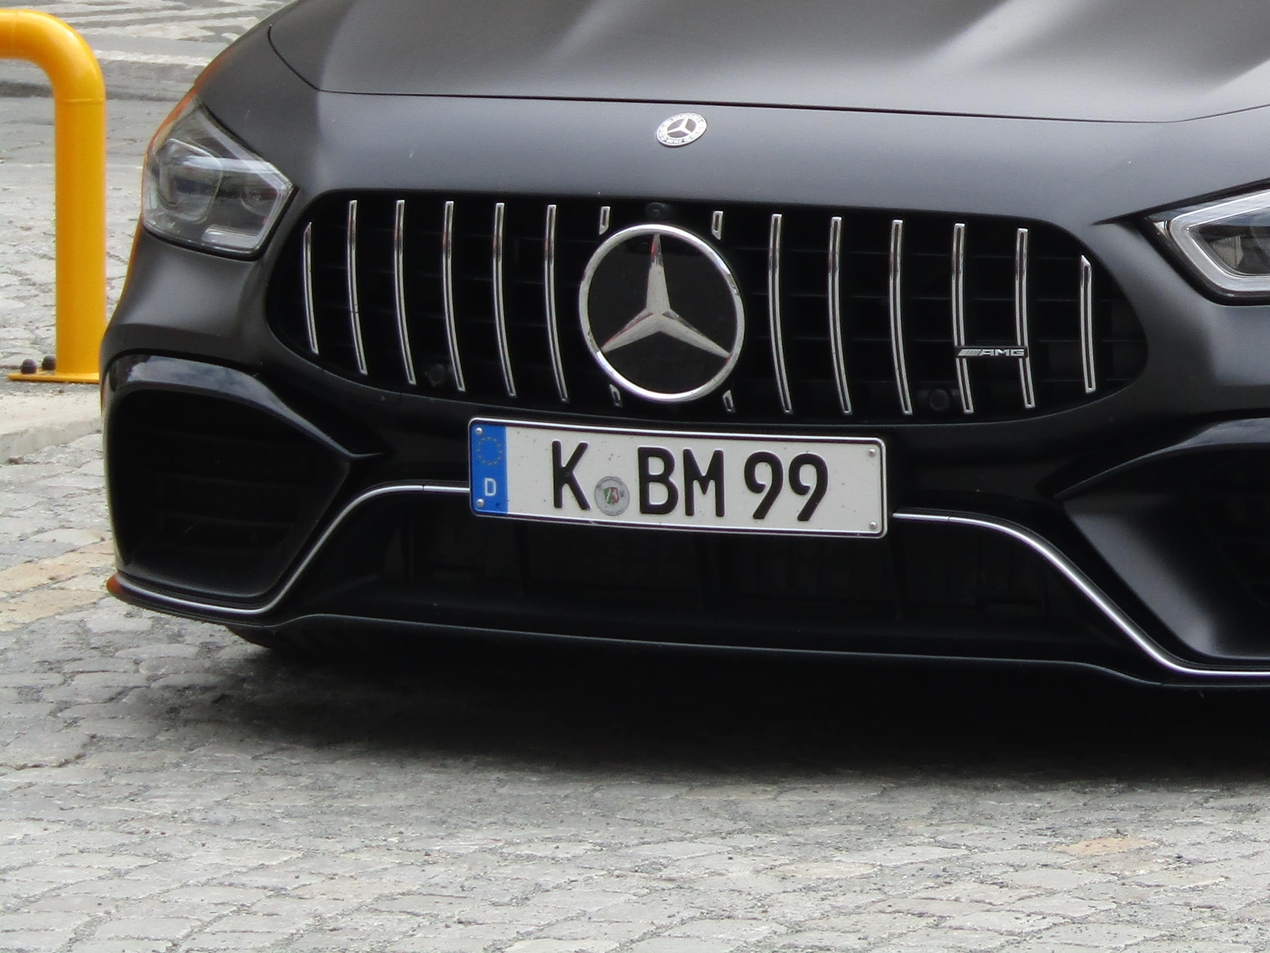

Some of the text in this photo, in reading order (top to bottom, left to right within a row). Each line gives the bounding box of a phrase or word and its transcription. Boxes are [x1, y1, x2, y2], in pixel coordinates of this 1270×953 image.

[484, 477, 497, 497] D
[552, 440, 591, 510] K
[638, 445, 725, 517] BM
[743, 451, 828, 521] 99
